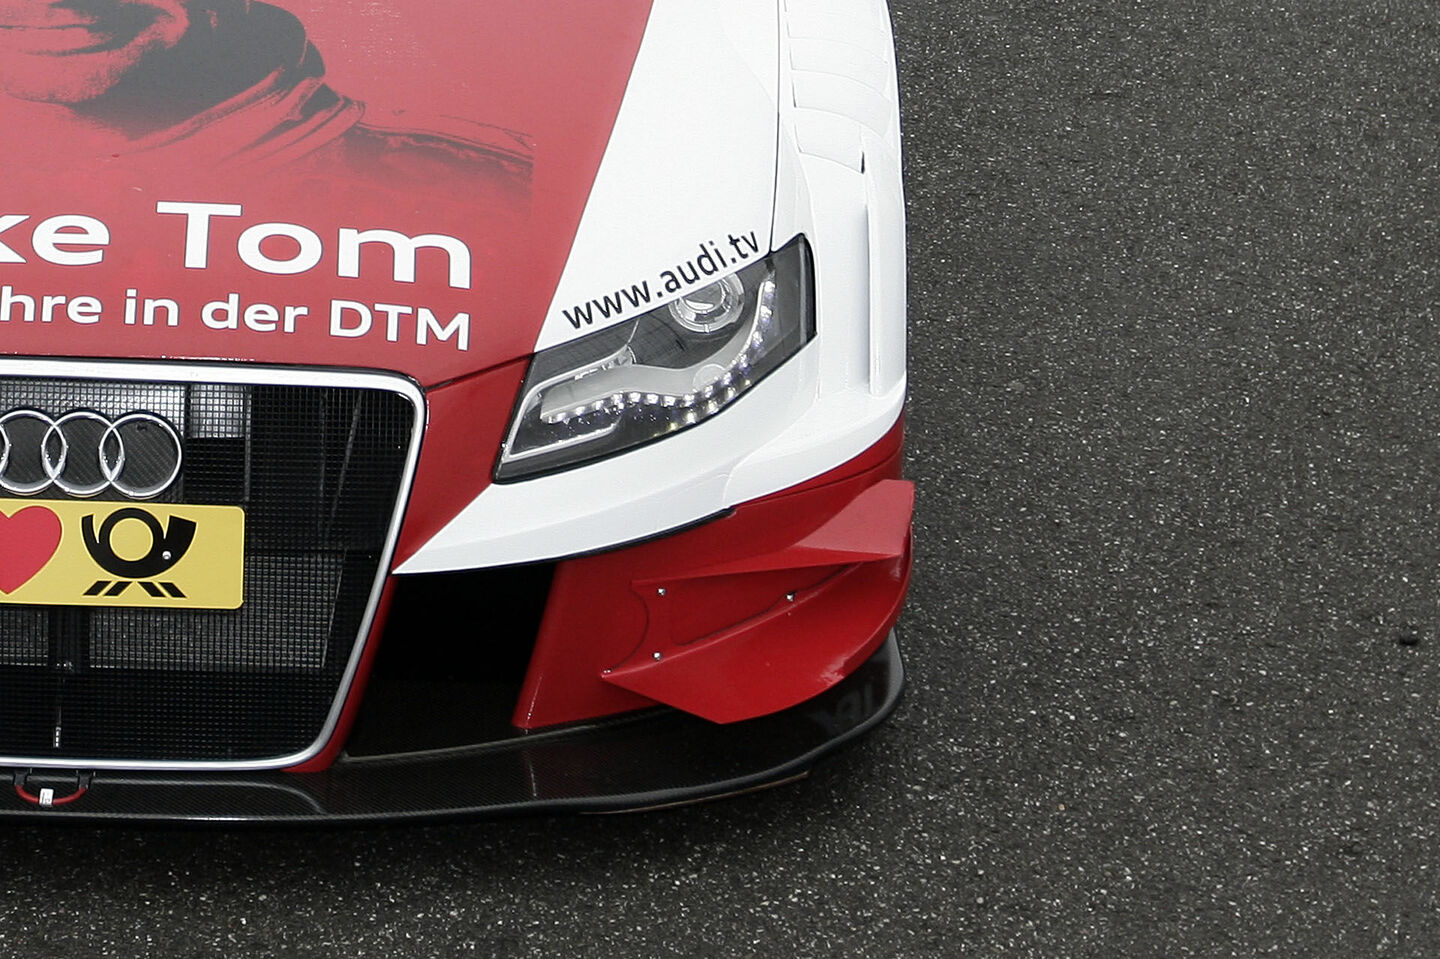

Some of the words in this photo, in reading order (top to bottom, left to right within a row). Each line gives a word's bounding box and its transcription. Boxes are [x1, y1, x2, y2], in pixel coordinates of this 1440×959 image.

[156, 200, 472, 290] Tom
[561, 230, 760, 330] www.audi.tv
[124, 288, 180, 327] in
[200, 292, 310, 334] der
[328, 298, 471, 351] DTM
